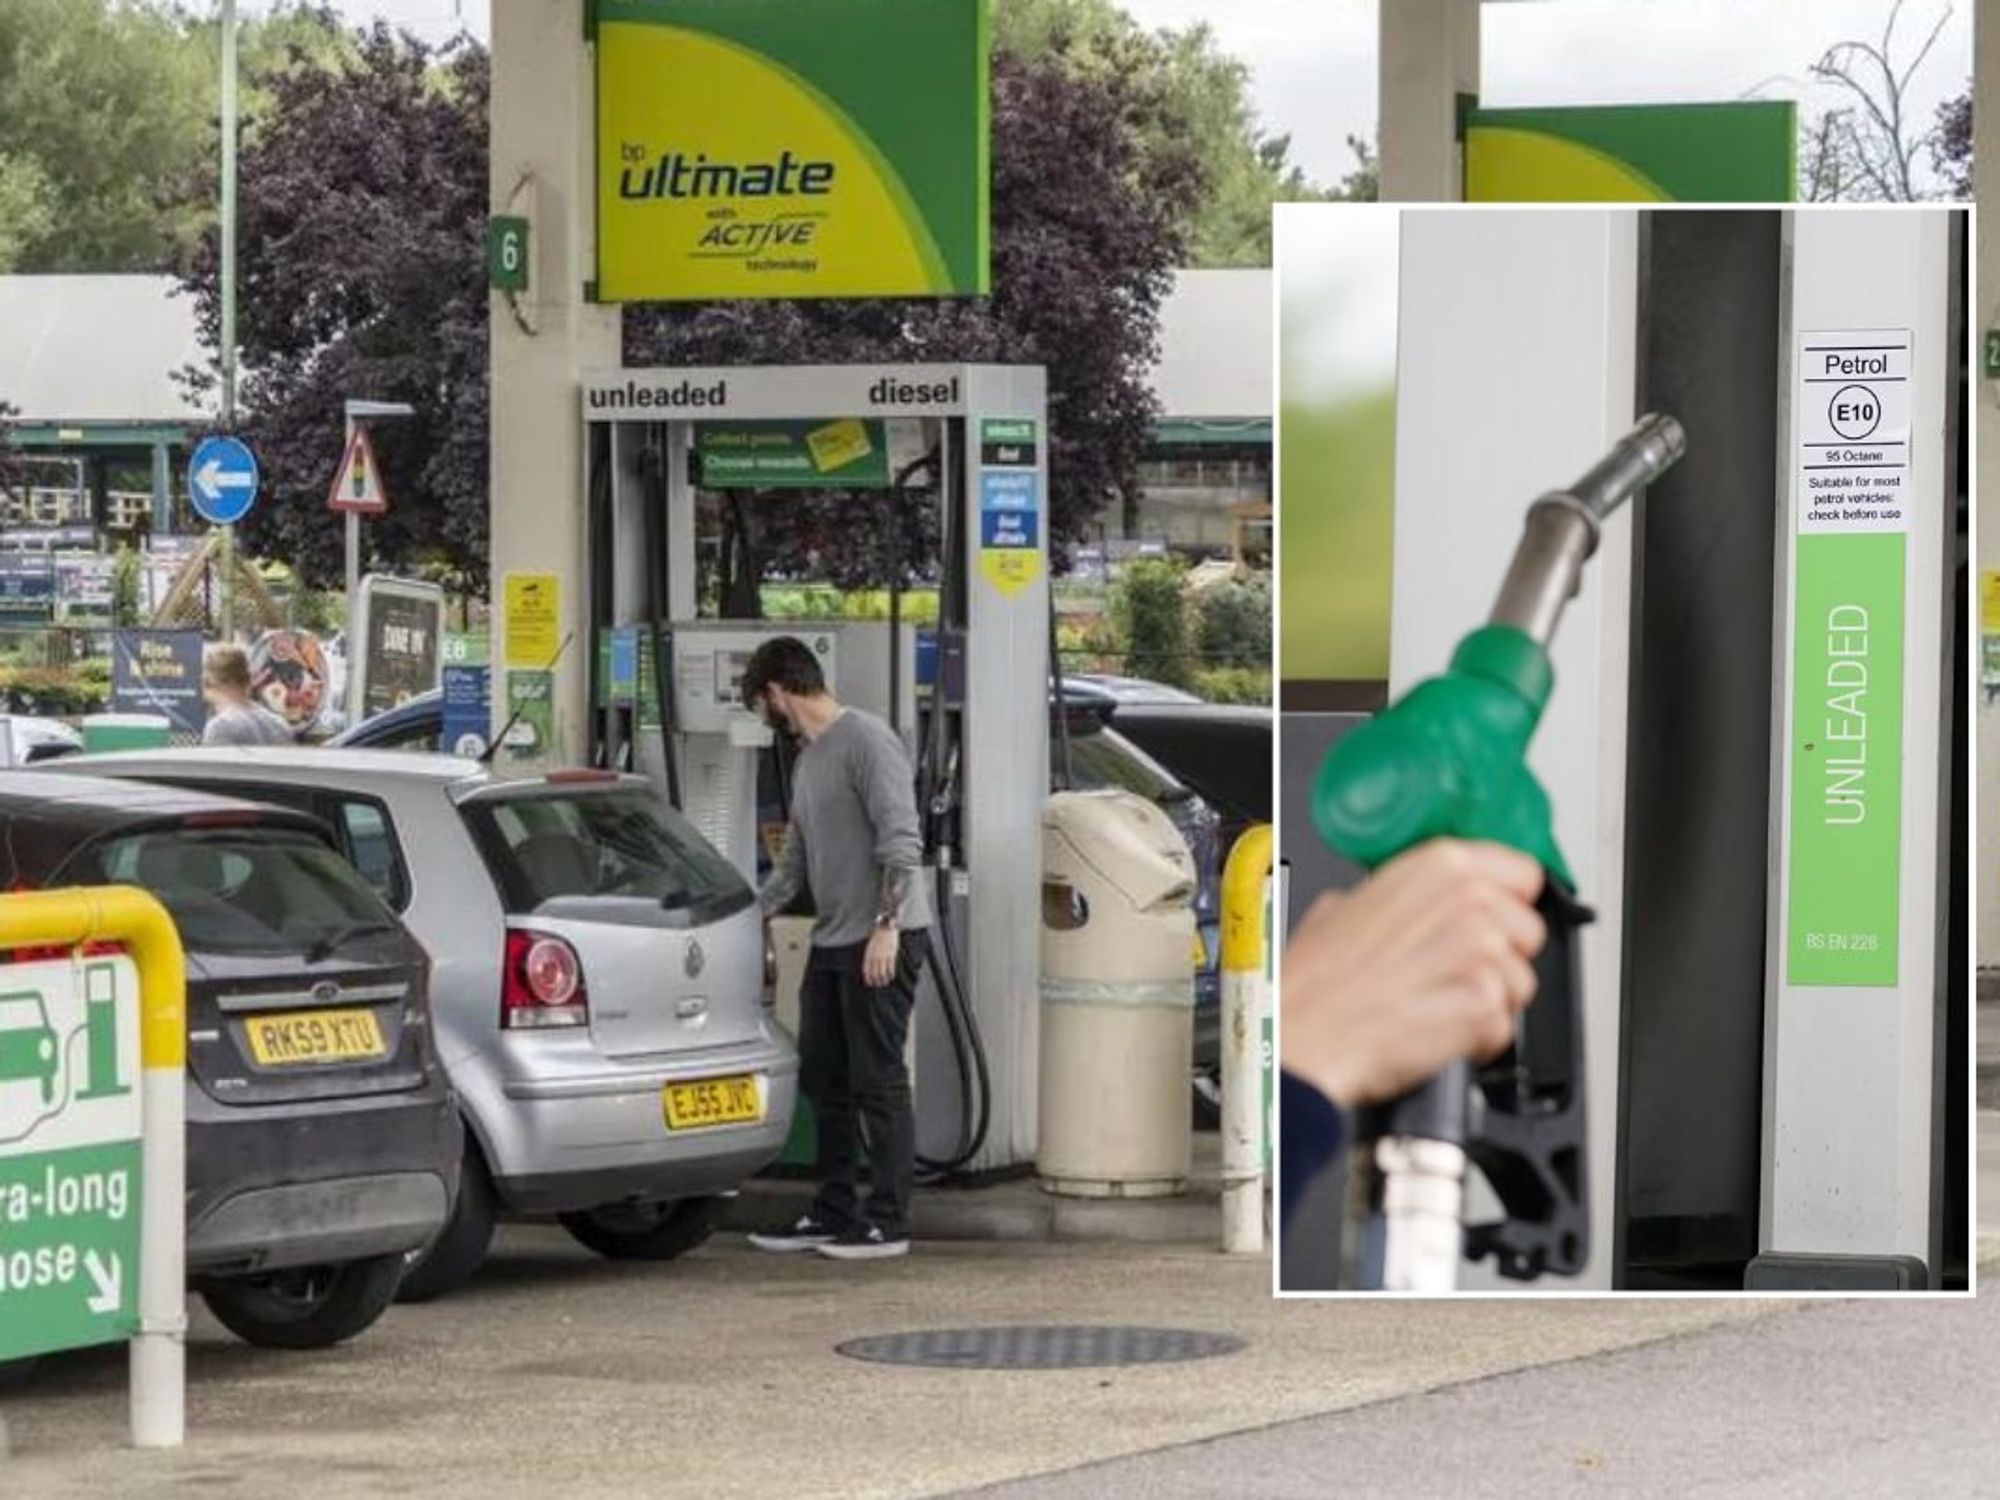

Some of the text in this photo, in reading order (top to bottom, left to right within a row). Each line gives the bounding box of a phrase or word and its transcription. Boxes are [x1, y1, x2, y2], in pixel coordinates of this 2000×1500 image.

[621, 142, 645, 162] bp
[620, 151, 834, 199] ultimate
[698, 221, 817, 248] ACTIVE
[502, 231, 519, 271] 6
[1825, 354, 1888, 374] Petrol
[590, 376, 960, 408] unleaded diesel
[1836, 404, 1875, 421] E10
[1826, 450, 1884, 462] 95 Octane
[1809, 475, 1901, 489] Suitable for most
[1814, 494, 1845, 506] petrol
[1807, 508, 1902, 521] check before use
[1825, 604, 1870, 826] UNLEADED
[1806, 932, 1879, 951] BS EN 228
[328, 1016, 374, 1052] XTU
